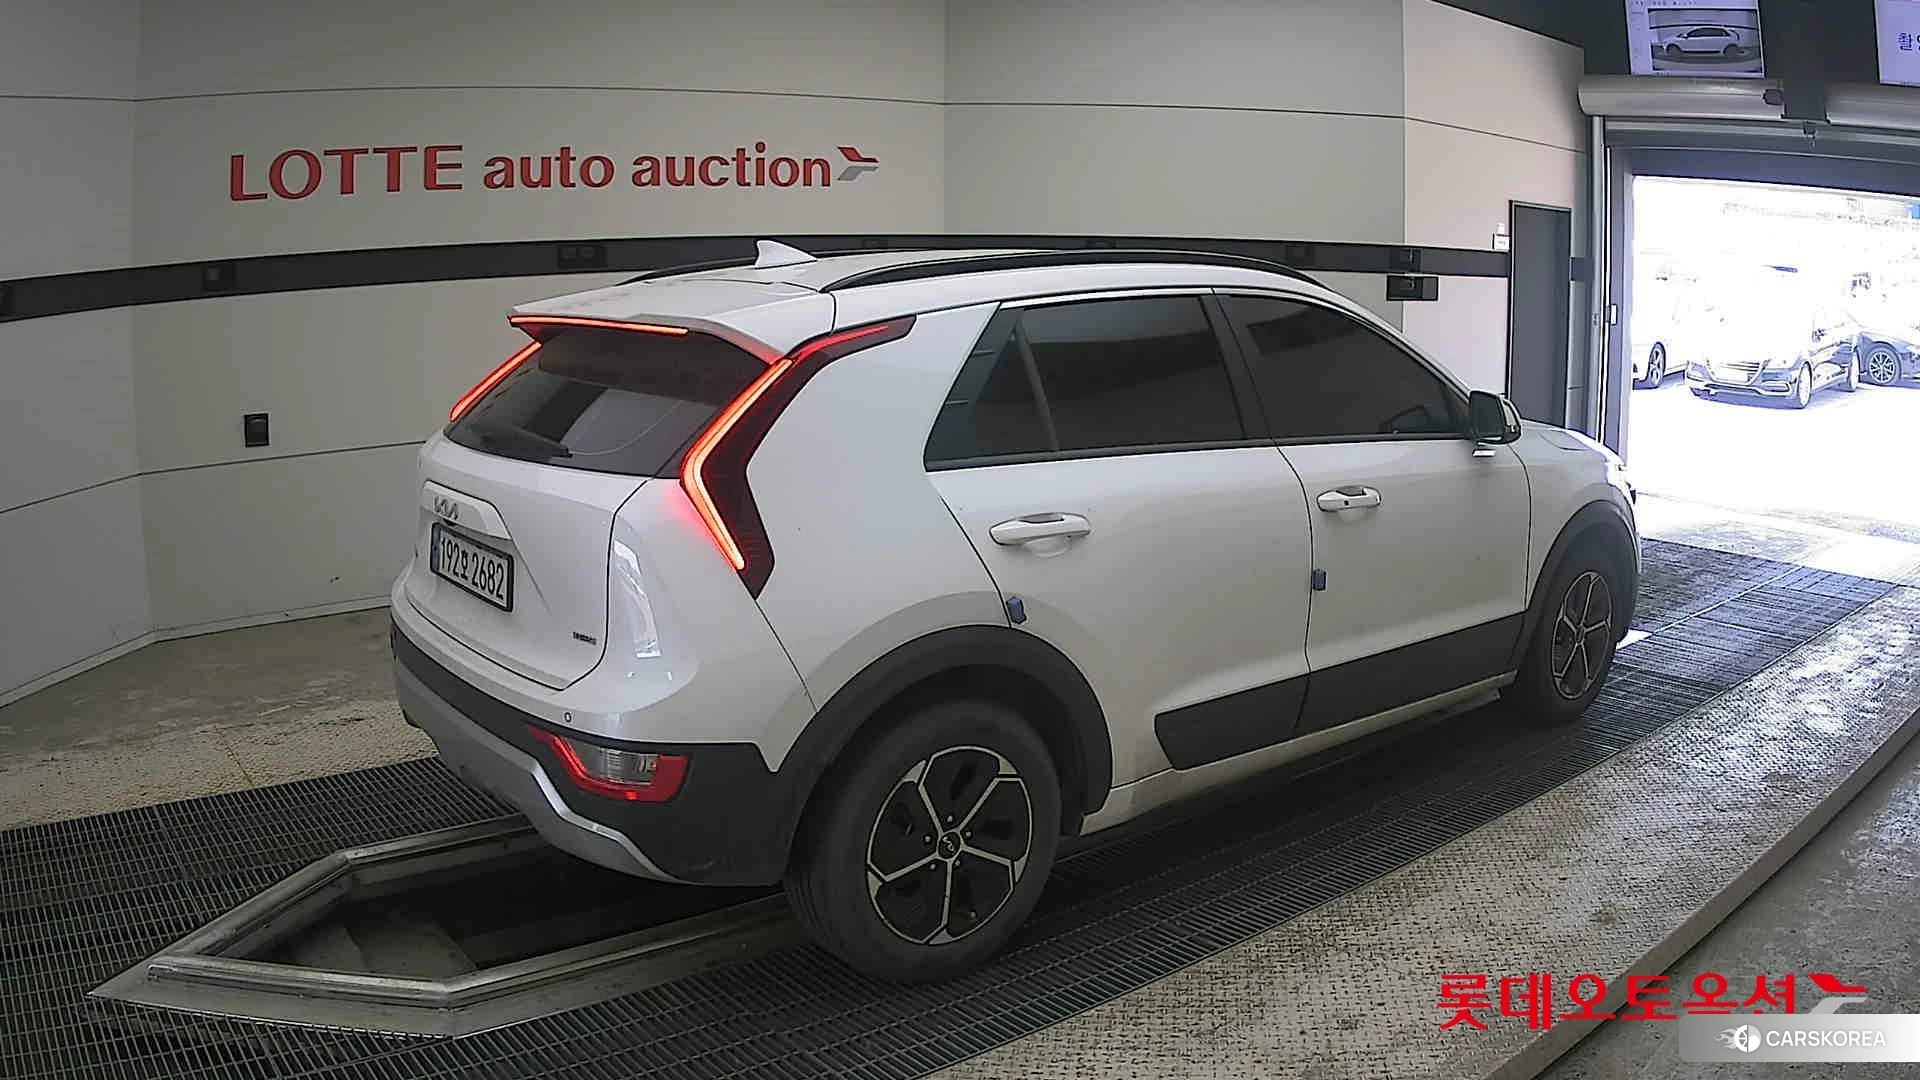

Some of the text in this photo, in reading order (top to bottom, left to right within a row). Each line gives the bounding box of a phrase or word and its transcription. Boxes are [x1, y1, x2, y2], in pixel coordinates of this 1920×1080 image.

[229, 142, 832, 201] LOTTE auto auction
[441, 536, 504, 601] 192호 2682
